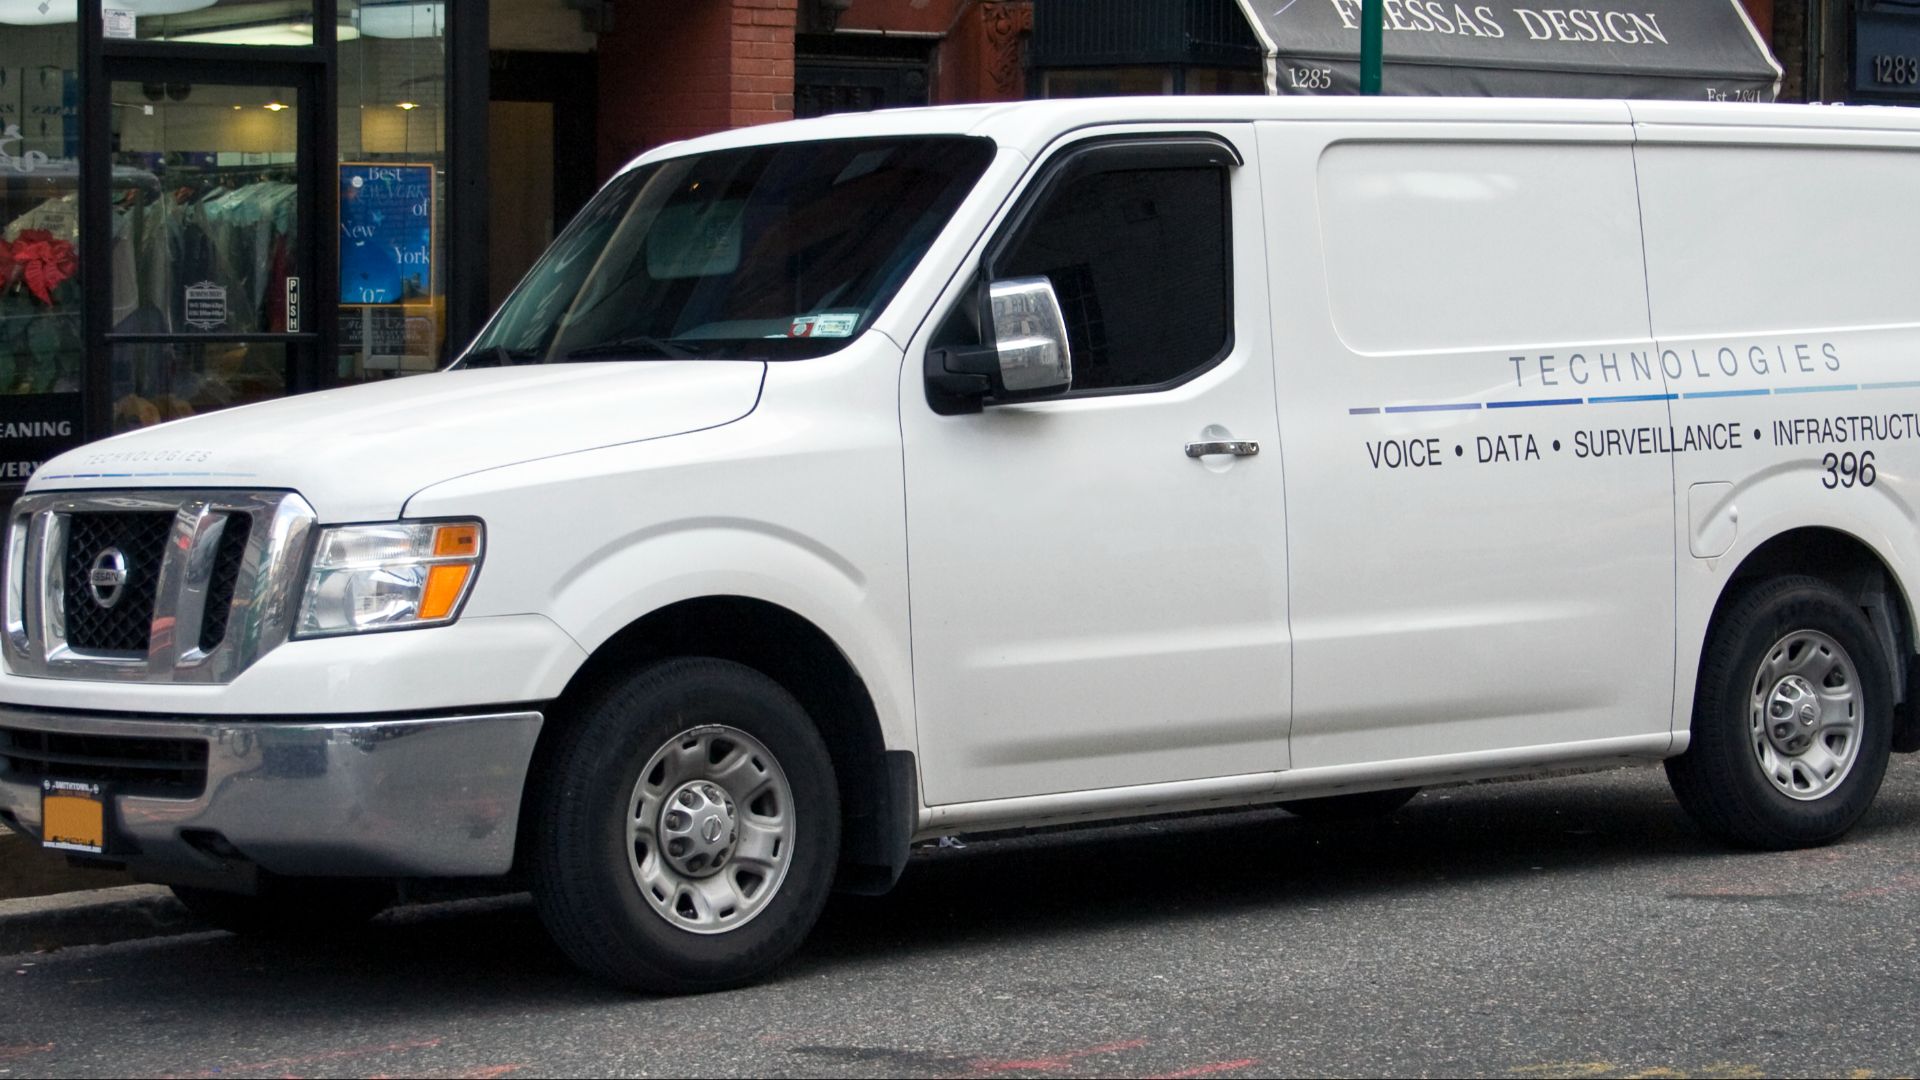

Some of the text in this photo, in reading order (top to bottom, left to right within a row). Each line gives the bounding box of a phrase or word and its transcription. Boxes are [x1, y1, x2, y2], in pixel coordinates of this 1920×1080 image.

[1513, 9, 1669, 45] DESIGN
[1288, 67, 1332, 89] 1285
[1875, 55, 1919, 84] 1283
[369, 167, 402, 181] Best
[413, 198, 430, 216] of
[394, 245, 430, 264] York
[1508, 343, 1840, 387] TECHNOLOGIES
[1366, 438, 1442, 469] VOICE
[1476, 434, 1540, 463] DATA
[1574, 422, 1742, 458] SURVEILLANCE
[1822, 450, 1876, 489] 396
